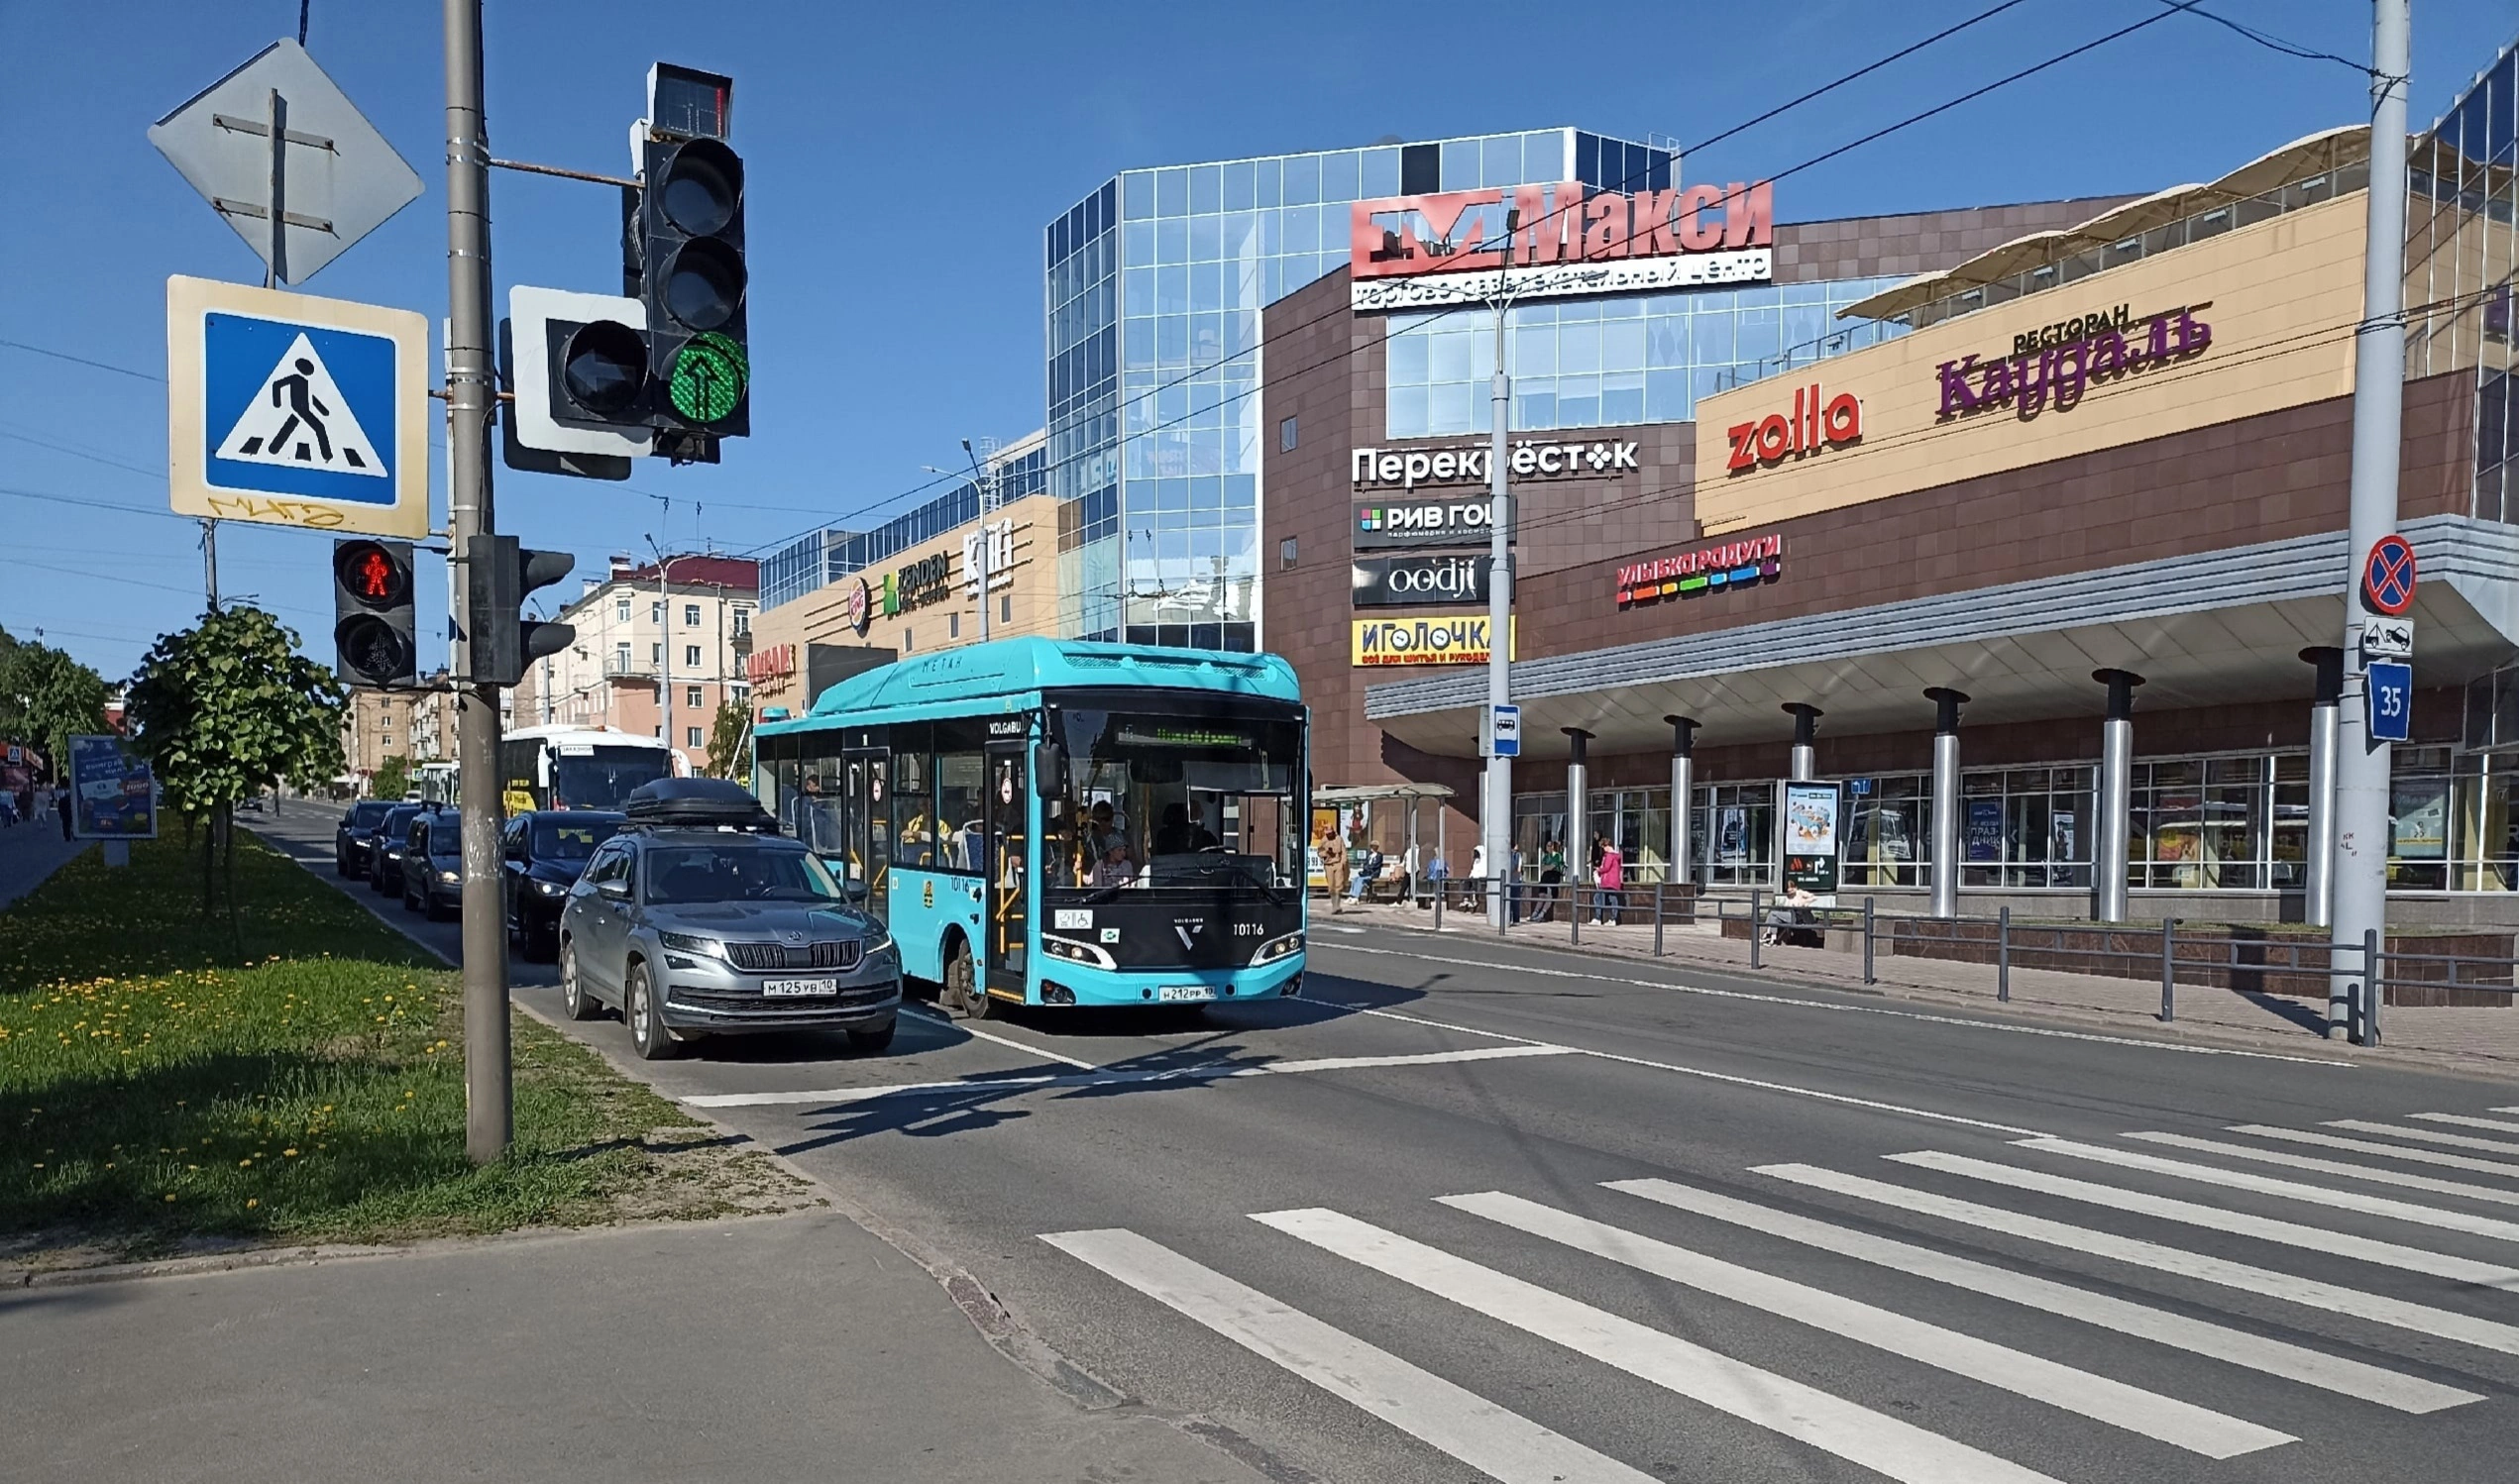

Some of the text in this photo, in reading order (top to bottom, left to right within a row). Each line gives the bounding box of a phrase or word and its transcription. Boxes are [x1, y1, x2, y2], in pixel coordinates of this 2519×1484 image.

[1514, 179, 1772, 265] Макси
[2014, 303, 2130, 356] РЕСТОРАН
[1726, 382, 1863, 470] zolla
[1387, 506, 1444, 530] РИВ
[1387, 529, 1446, 540] парфюмерия
[898, 550, 947, 596] ZENDEN
[1388, 558, 1477, 598] oodji
[922, 656, 962, 674] МЕТАН
[1403, 654, 1437, 663] ШИТЬЯ
[1439, 653, 1446, 662] И
[2380, 686, 2401, 717] 35
[989, 721, 1022, 734] VOLGABU
[950, 877, 970, 894] 10116
[1234, 923, 1264, 936] 10116
